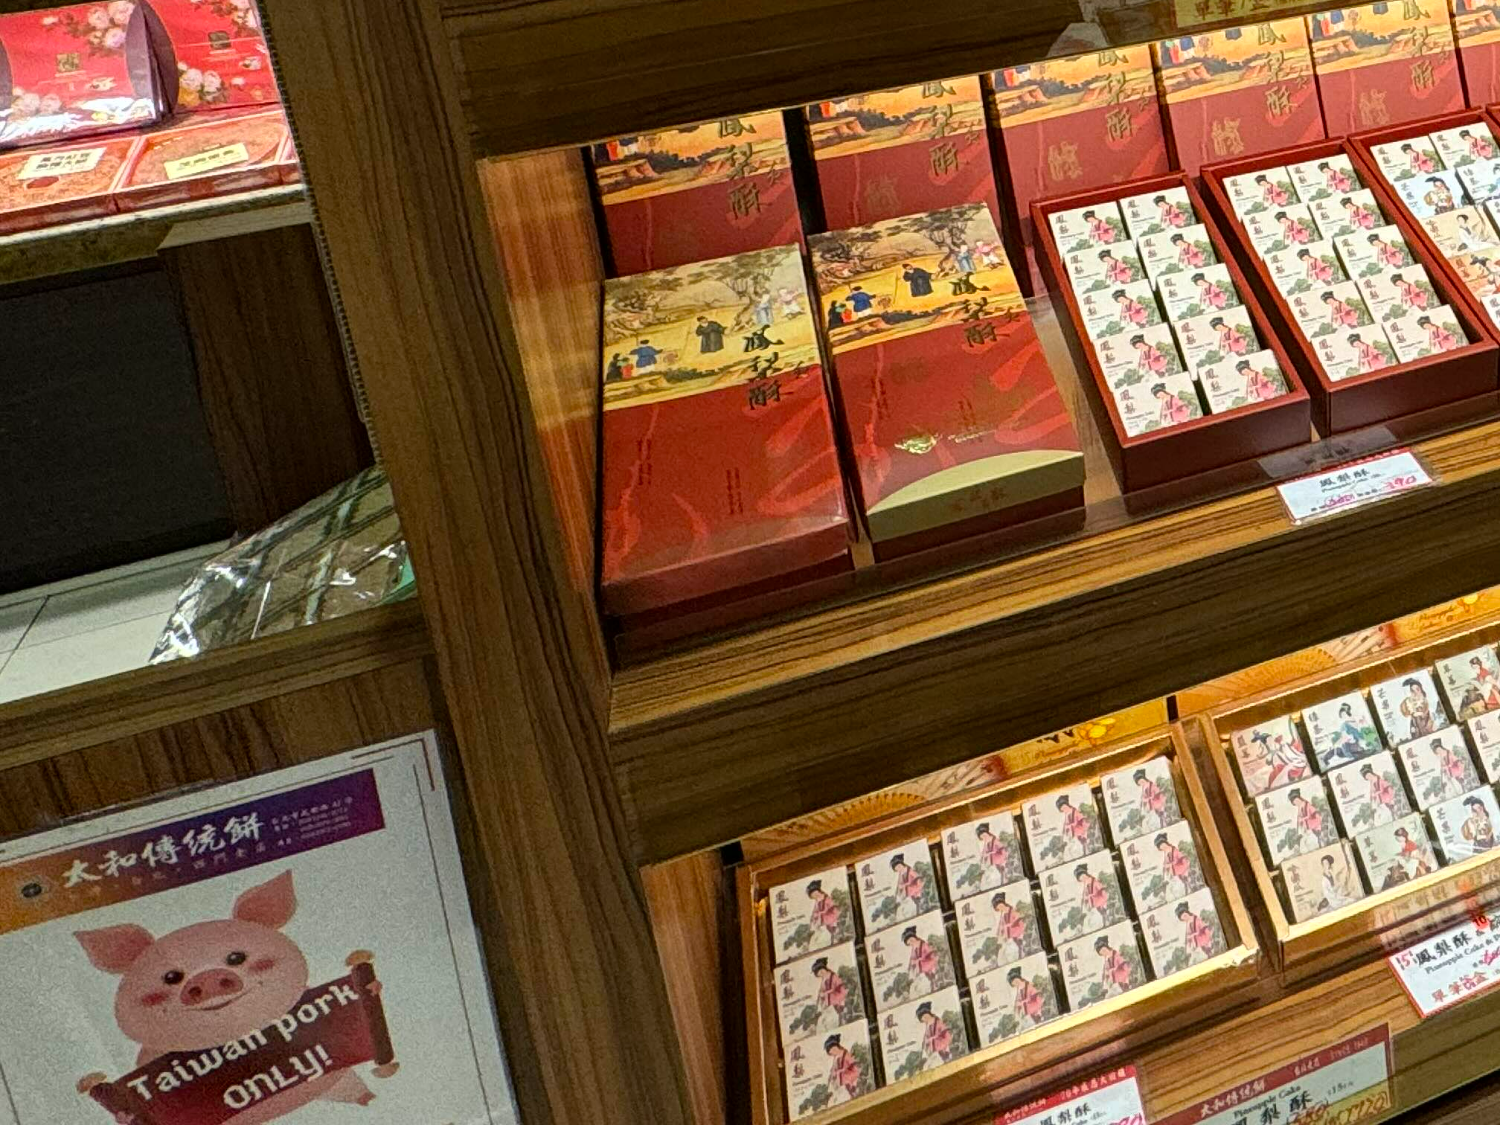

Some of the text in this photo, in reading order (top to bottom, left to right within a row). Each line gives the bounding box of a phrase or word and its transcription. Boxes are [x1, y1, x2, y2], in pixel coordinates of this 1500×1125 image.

[1319, 468, 1371, 488] 鳳梨酥
[1414, 930, 1473, 968] 鳳梨酥
[1425, 953, 1464, 975] Pineapple
[1464, 943, 1486, 957] Cake
[127, 979, 362, 1103] Taiwan pork
[1233, 1085, 1303, 1116] Pineapple Cake
